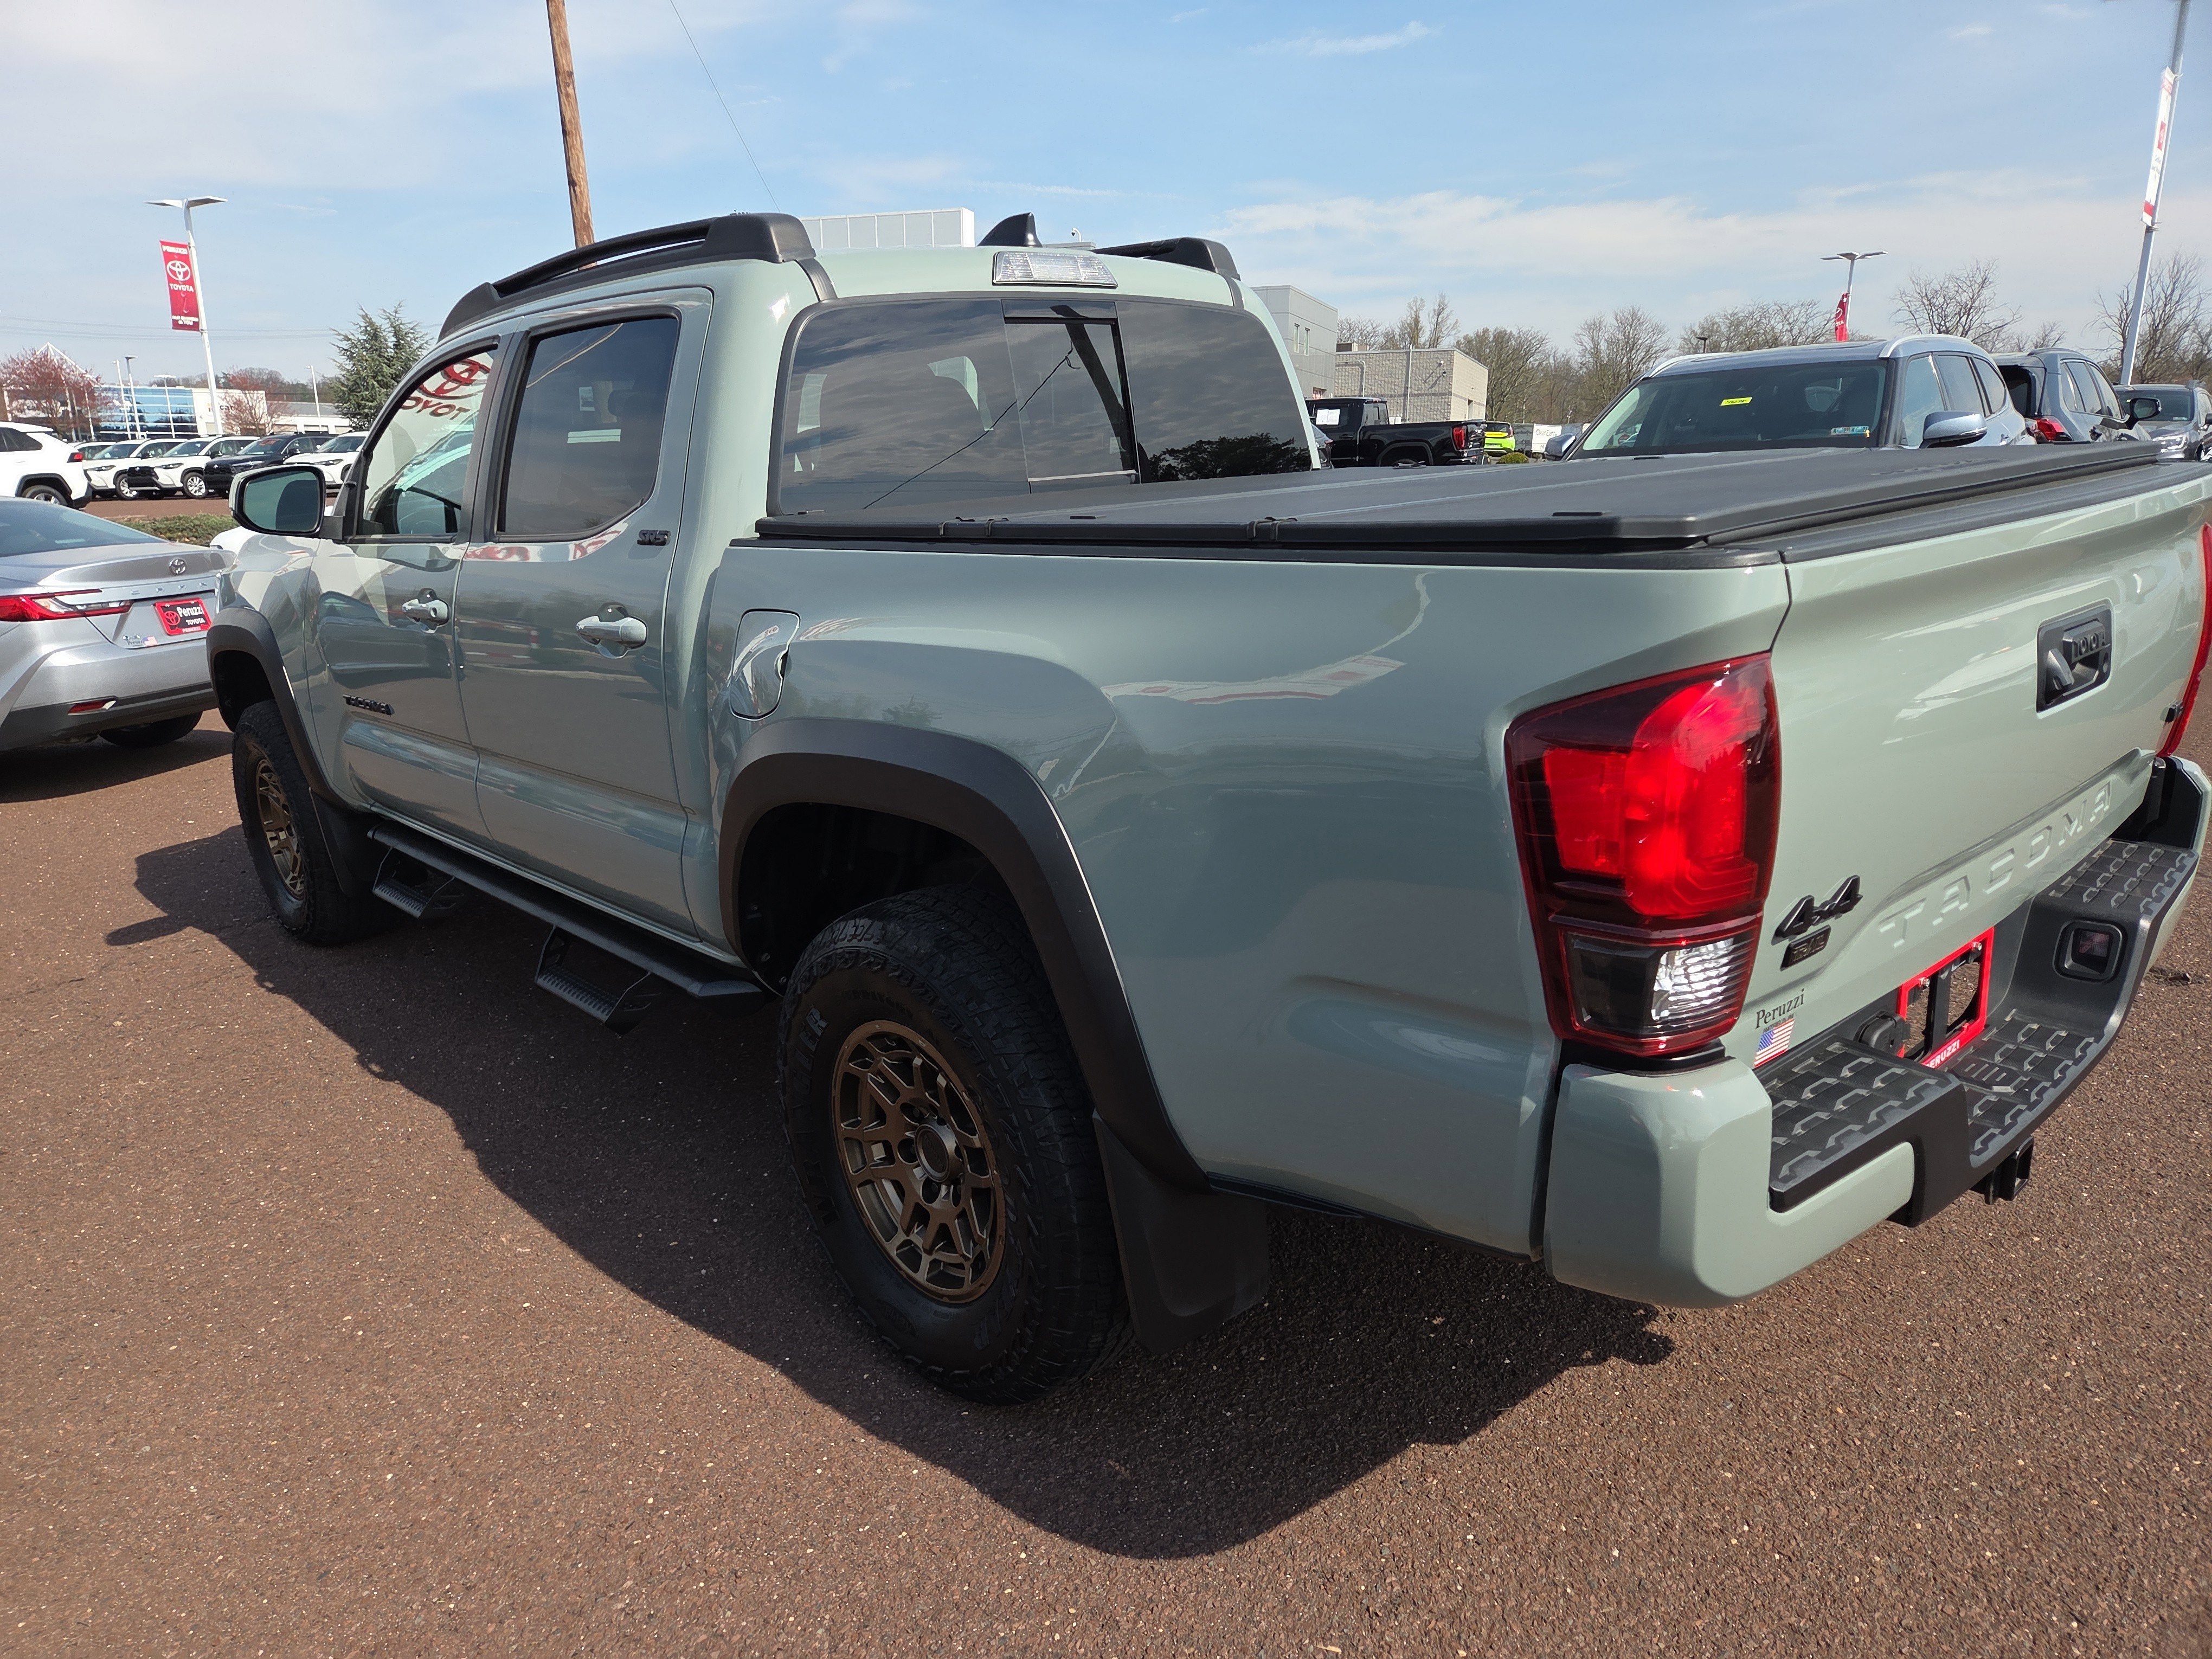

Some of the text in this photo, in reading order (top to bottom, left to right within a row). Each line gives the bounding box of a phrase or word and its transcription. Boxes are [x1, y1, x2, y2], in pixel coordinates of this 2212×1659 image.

[169, 283, 194, 292] TOYOTA
[637, 529, 671, 546] SR5
[177, 604, 204, 618] Peruzzi
[343, 695, 395, 716] TACOMA
[1879, 781, 2112, 949] TACOMA
[1756, 988, 1804, 1029] Peruzzi
